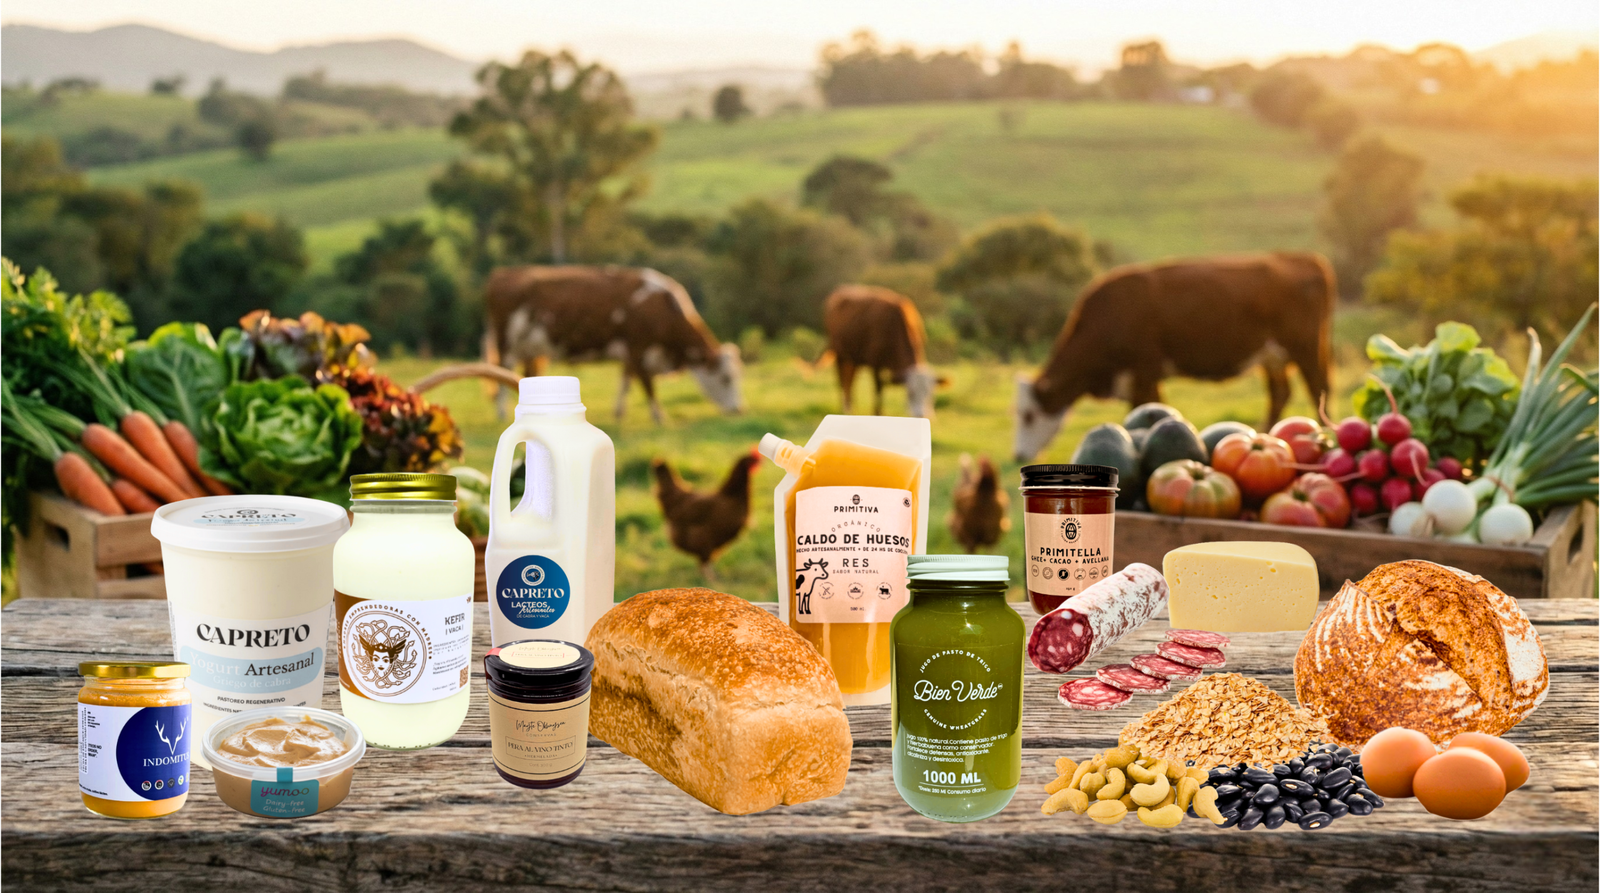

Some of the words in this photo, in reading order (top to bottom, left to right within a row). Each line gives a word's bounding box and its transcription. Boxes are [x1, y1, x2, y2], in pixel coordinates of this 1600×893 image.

[1060, 518, 1082, 529] PRIMITIVA
[798, 534, 837, 546] CALDO
[844, 534, 860, 544] DE
[866, 534, 910, 548] HUESOS
[1040, 547, 1101, 557] PRIMITELLA
[843, 558, 869, 567] RES
[1082, 556, 1109, 564] AVELLANA
[502, 588, 564, 598] CAPRETO
[407, 614, 420, 625] CON
[445, 613, 465, 625] KEFIR
[197, 623, 310, 648] CAPRETO
[190, 651, 240, 674] Yogurt
[244, 652, 314, 676] Artesanal
[920, 659, 931, 673] JUGO
[977, 657, 990, 672] TRIGO
[213, 676, 246, 688] Griego
[250, 679, 262, 688] de
[265, 678, 291, 687] cabra
[914, 680, 952, 702] Bien
[952, 680, 998, 702] Verde
[217, 696, 244, 704] PASTOREO
[203, 702, 232, 713] INGREDIENTES
[924, 709, 947, 729] GENUINE
[950, 709, 987, 730] WHEATGRASS
[508, 742, 523, 751] PERA
[554, 742, 573, 751] TINTO
[143, 752, 189, 766] INDOMITUS
[923, 770, 956, 784] 1000
[961, 772, 981, 784] ML
[260, 786, 310, 797] yumoo
[266, 799, 304, 808] Dairy-free
